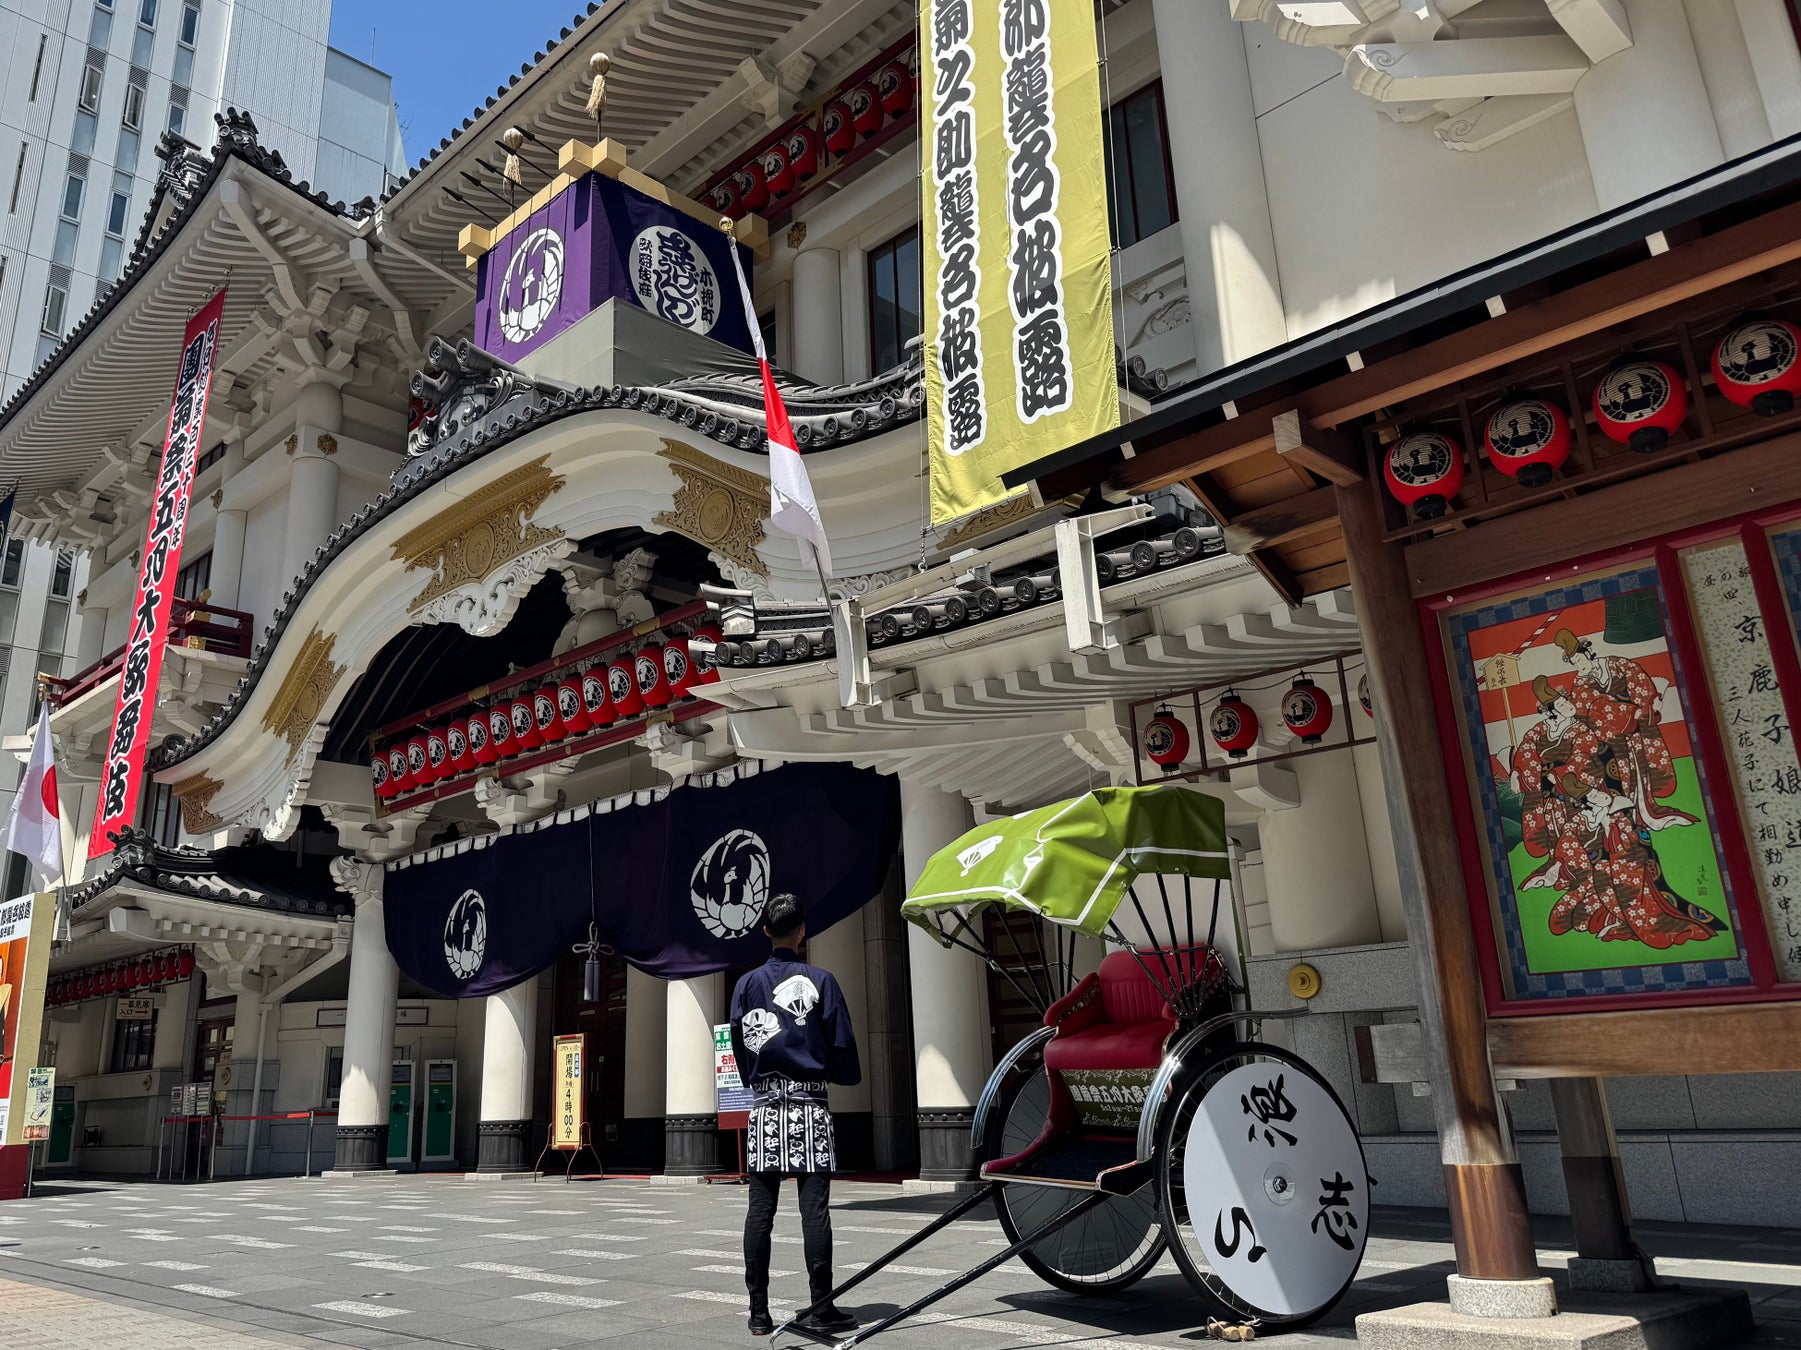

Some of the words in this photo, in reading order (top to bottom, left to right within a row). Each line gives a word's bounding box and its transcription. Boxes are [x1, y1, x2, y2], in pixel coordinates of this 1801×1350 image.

[638, 237, 652, 298] 歌舞伎座
[700, 267, 714, 325] 木挽町
[120, 1000, 150, 1009] 一幕見席
[1069, 1084, 1168, 1103] 團菊祭五月大歌
